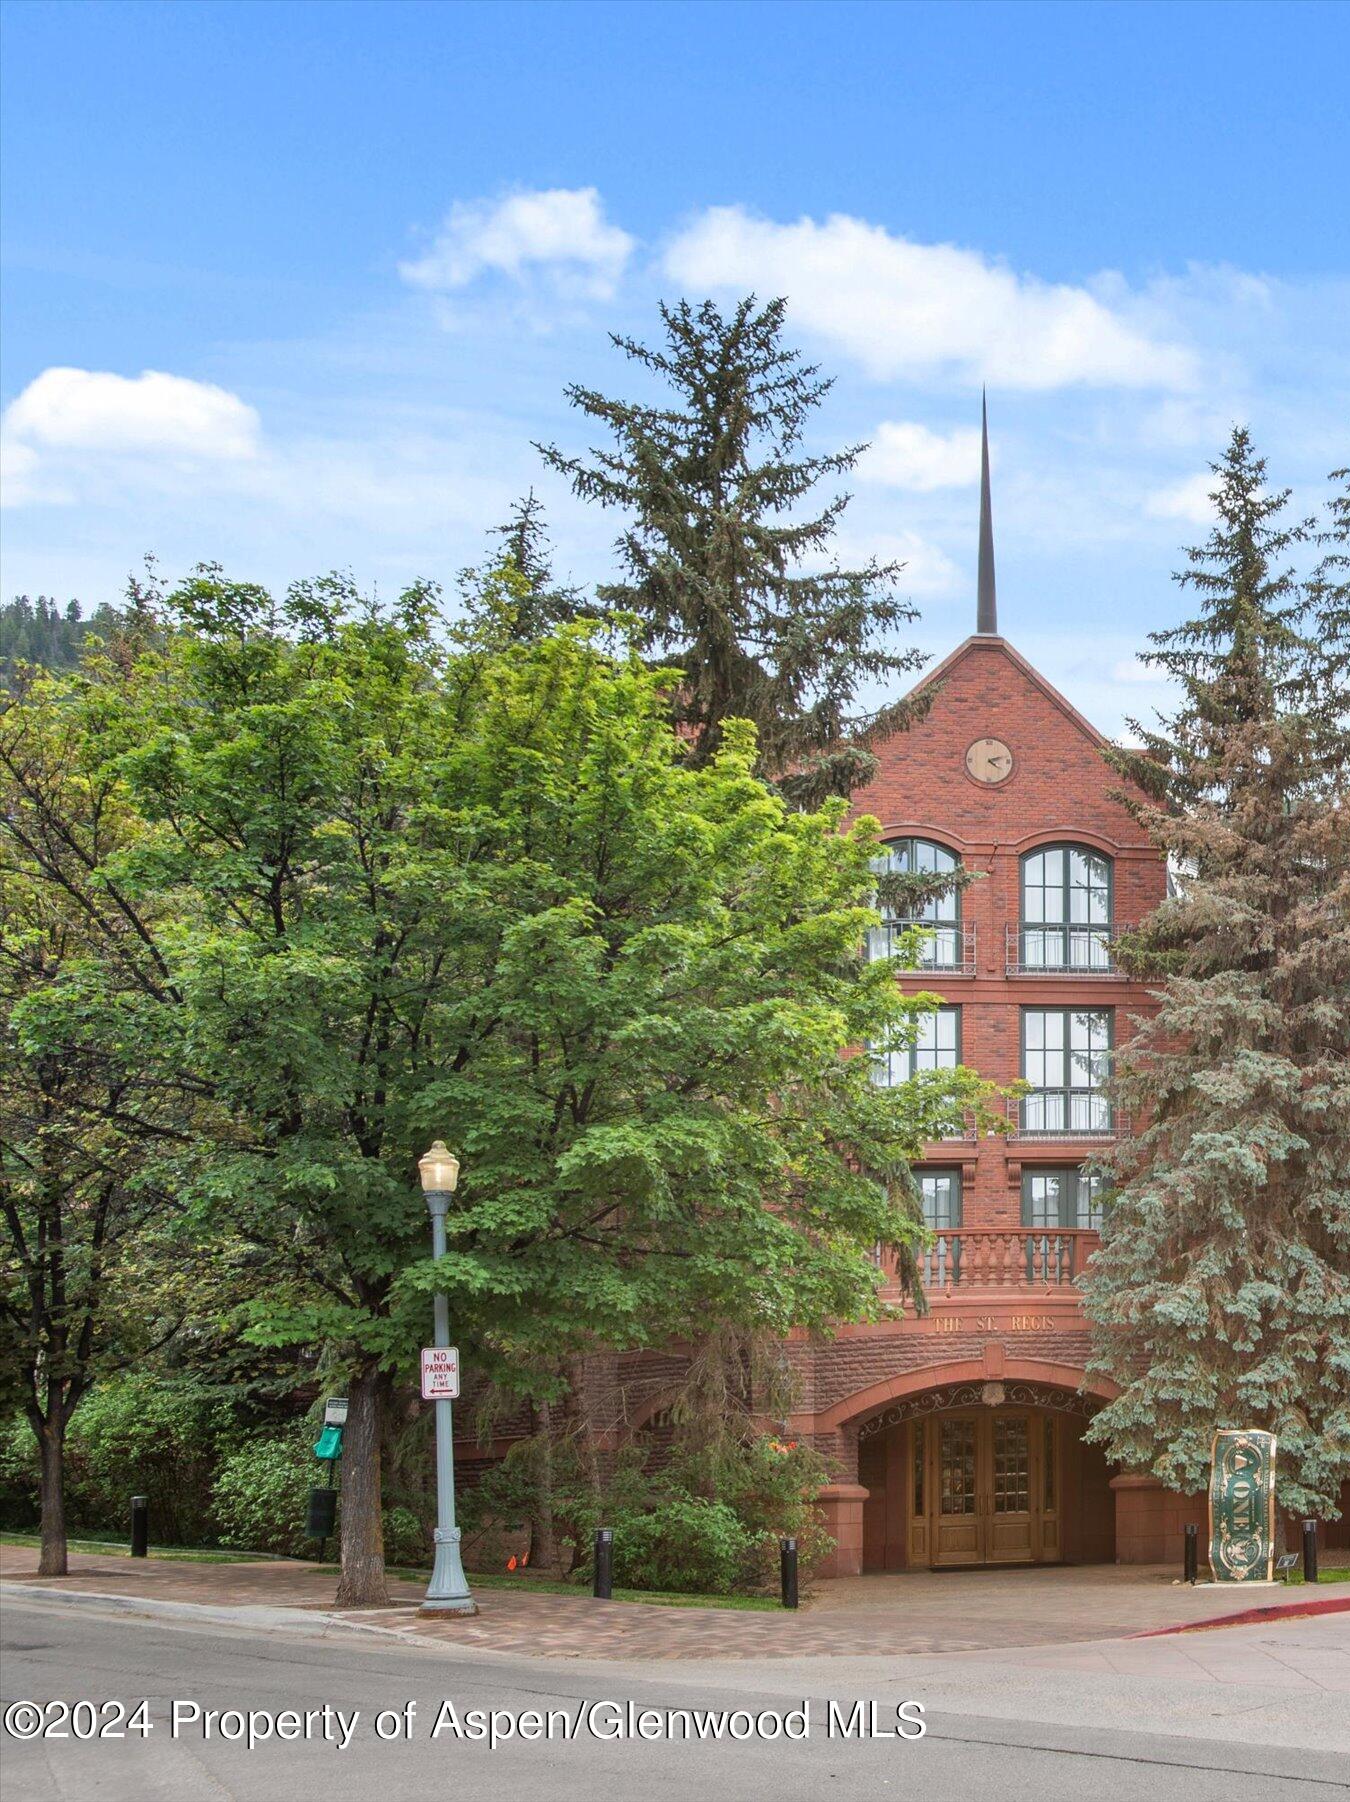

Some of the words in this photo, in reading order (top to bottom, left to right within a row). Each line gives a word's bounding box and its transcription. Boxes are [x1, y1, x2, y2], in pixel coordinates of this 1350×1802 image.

[935, 1317, 962, 1332] THE
[977, 1316, 998, 1331] ST.
[1011, 1315, 1055, 1330] REGIS
[433, 1352, 447, 1362] NO
[425, 1363, 456, 1373] PARKING
[1233, 1481, 1250, 1530] ONE
